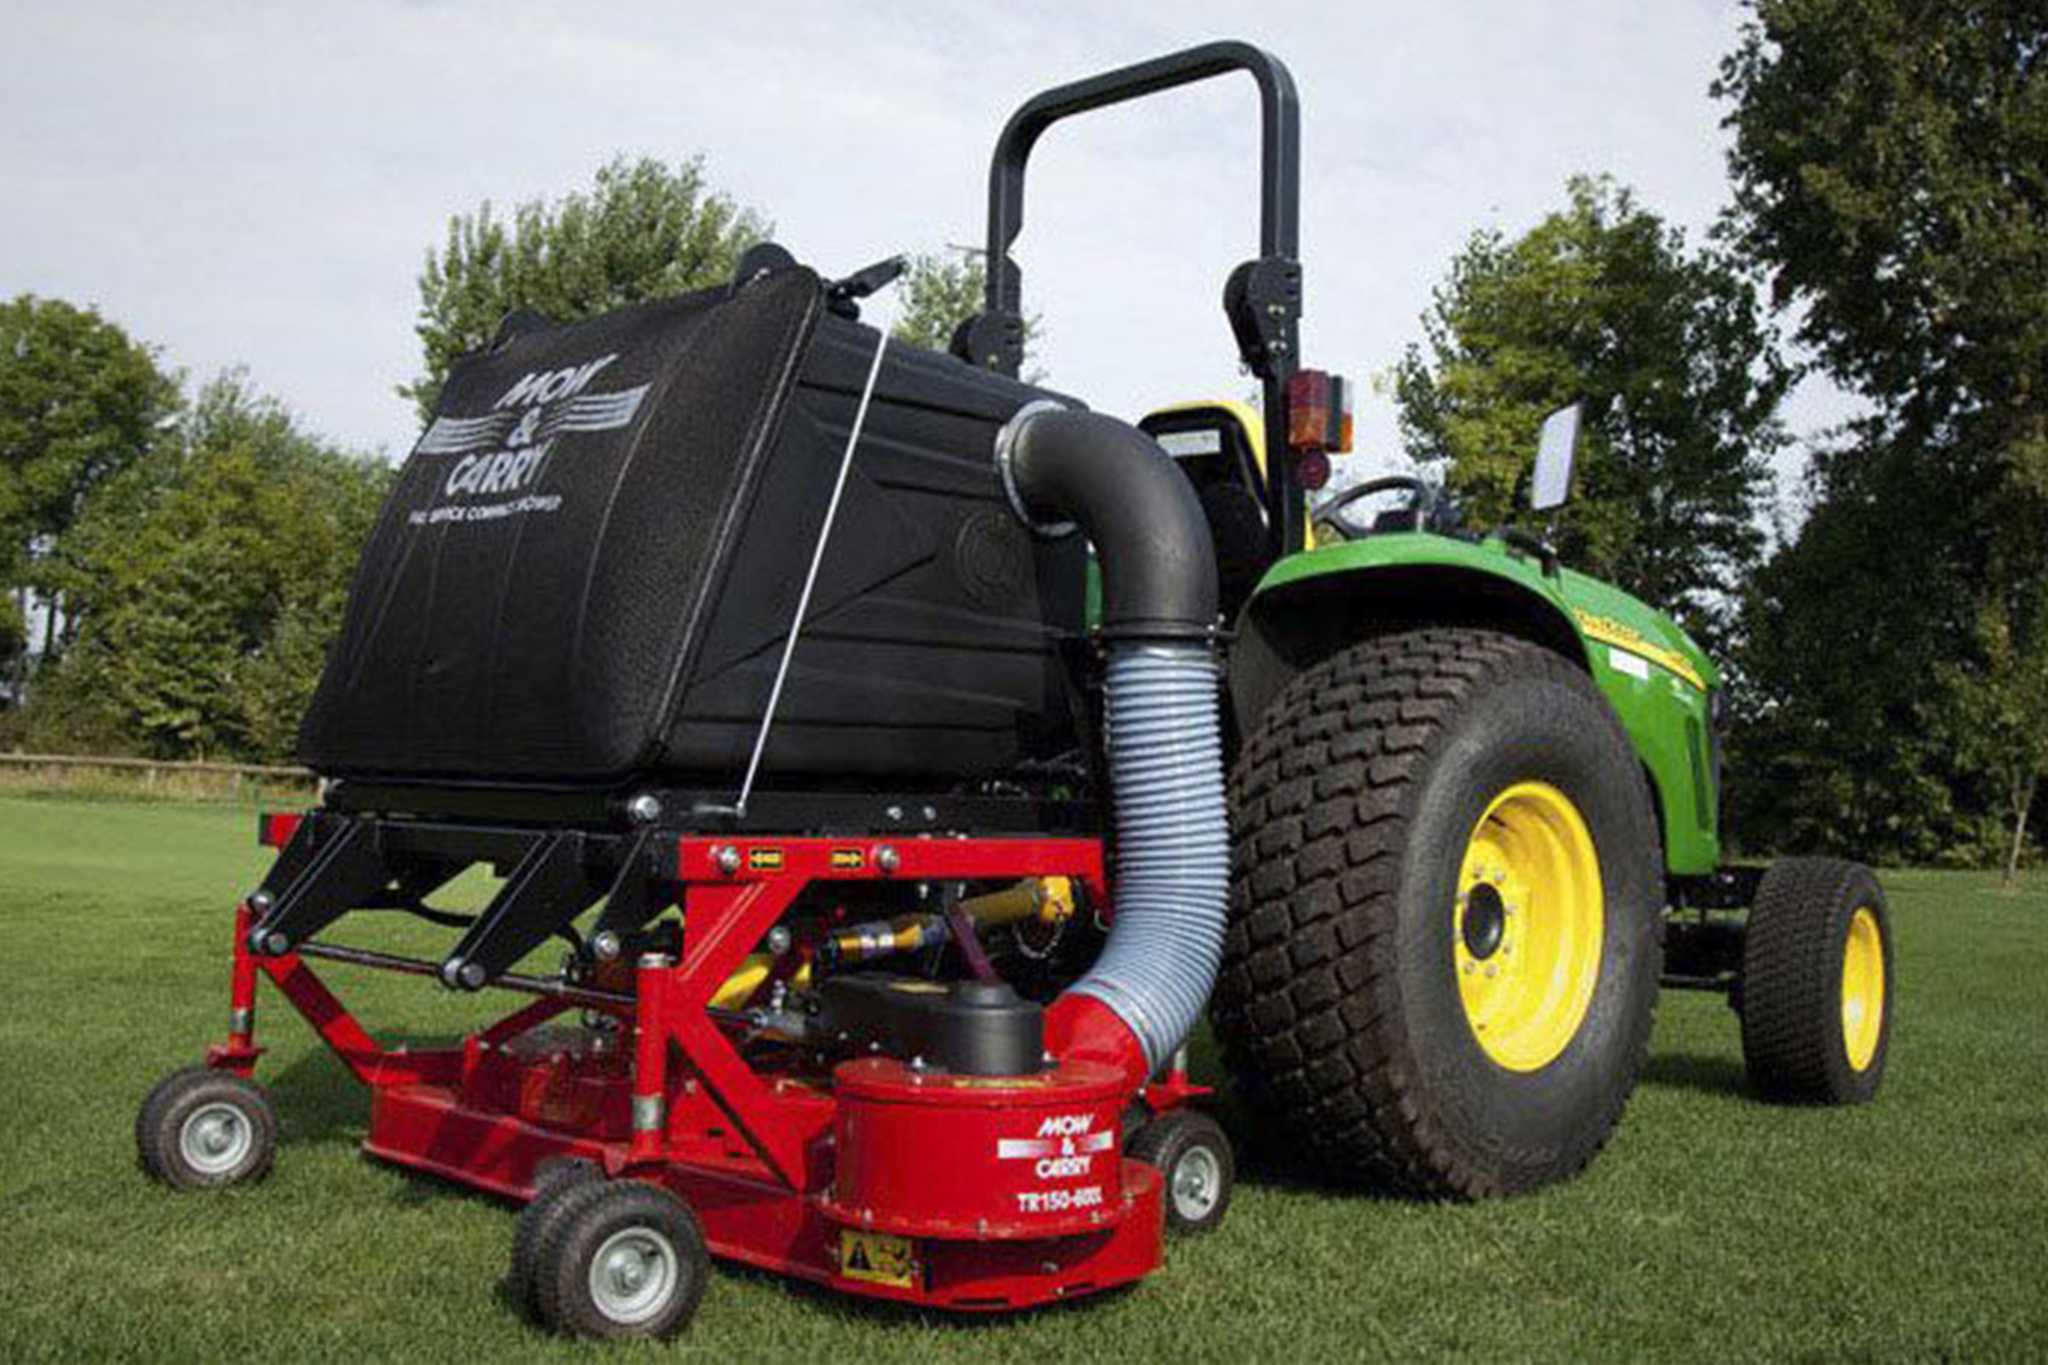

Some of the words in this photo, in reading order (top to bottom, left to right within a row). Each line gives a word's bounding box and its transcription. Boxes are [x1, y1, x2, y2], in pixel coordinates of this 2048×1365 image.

[493, 353, 619, 410] MOW
[506, 406, 542, 447] &
[446, 438, 555, 496] CARRY
[1038, 1113, 1094, 1137] MOW
[1036, 1156, 1091, 1179] CARRY
